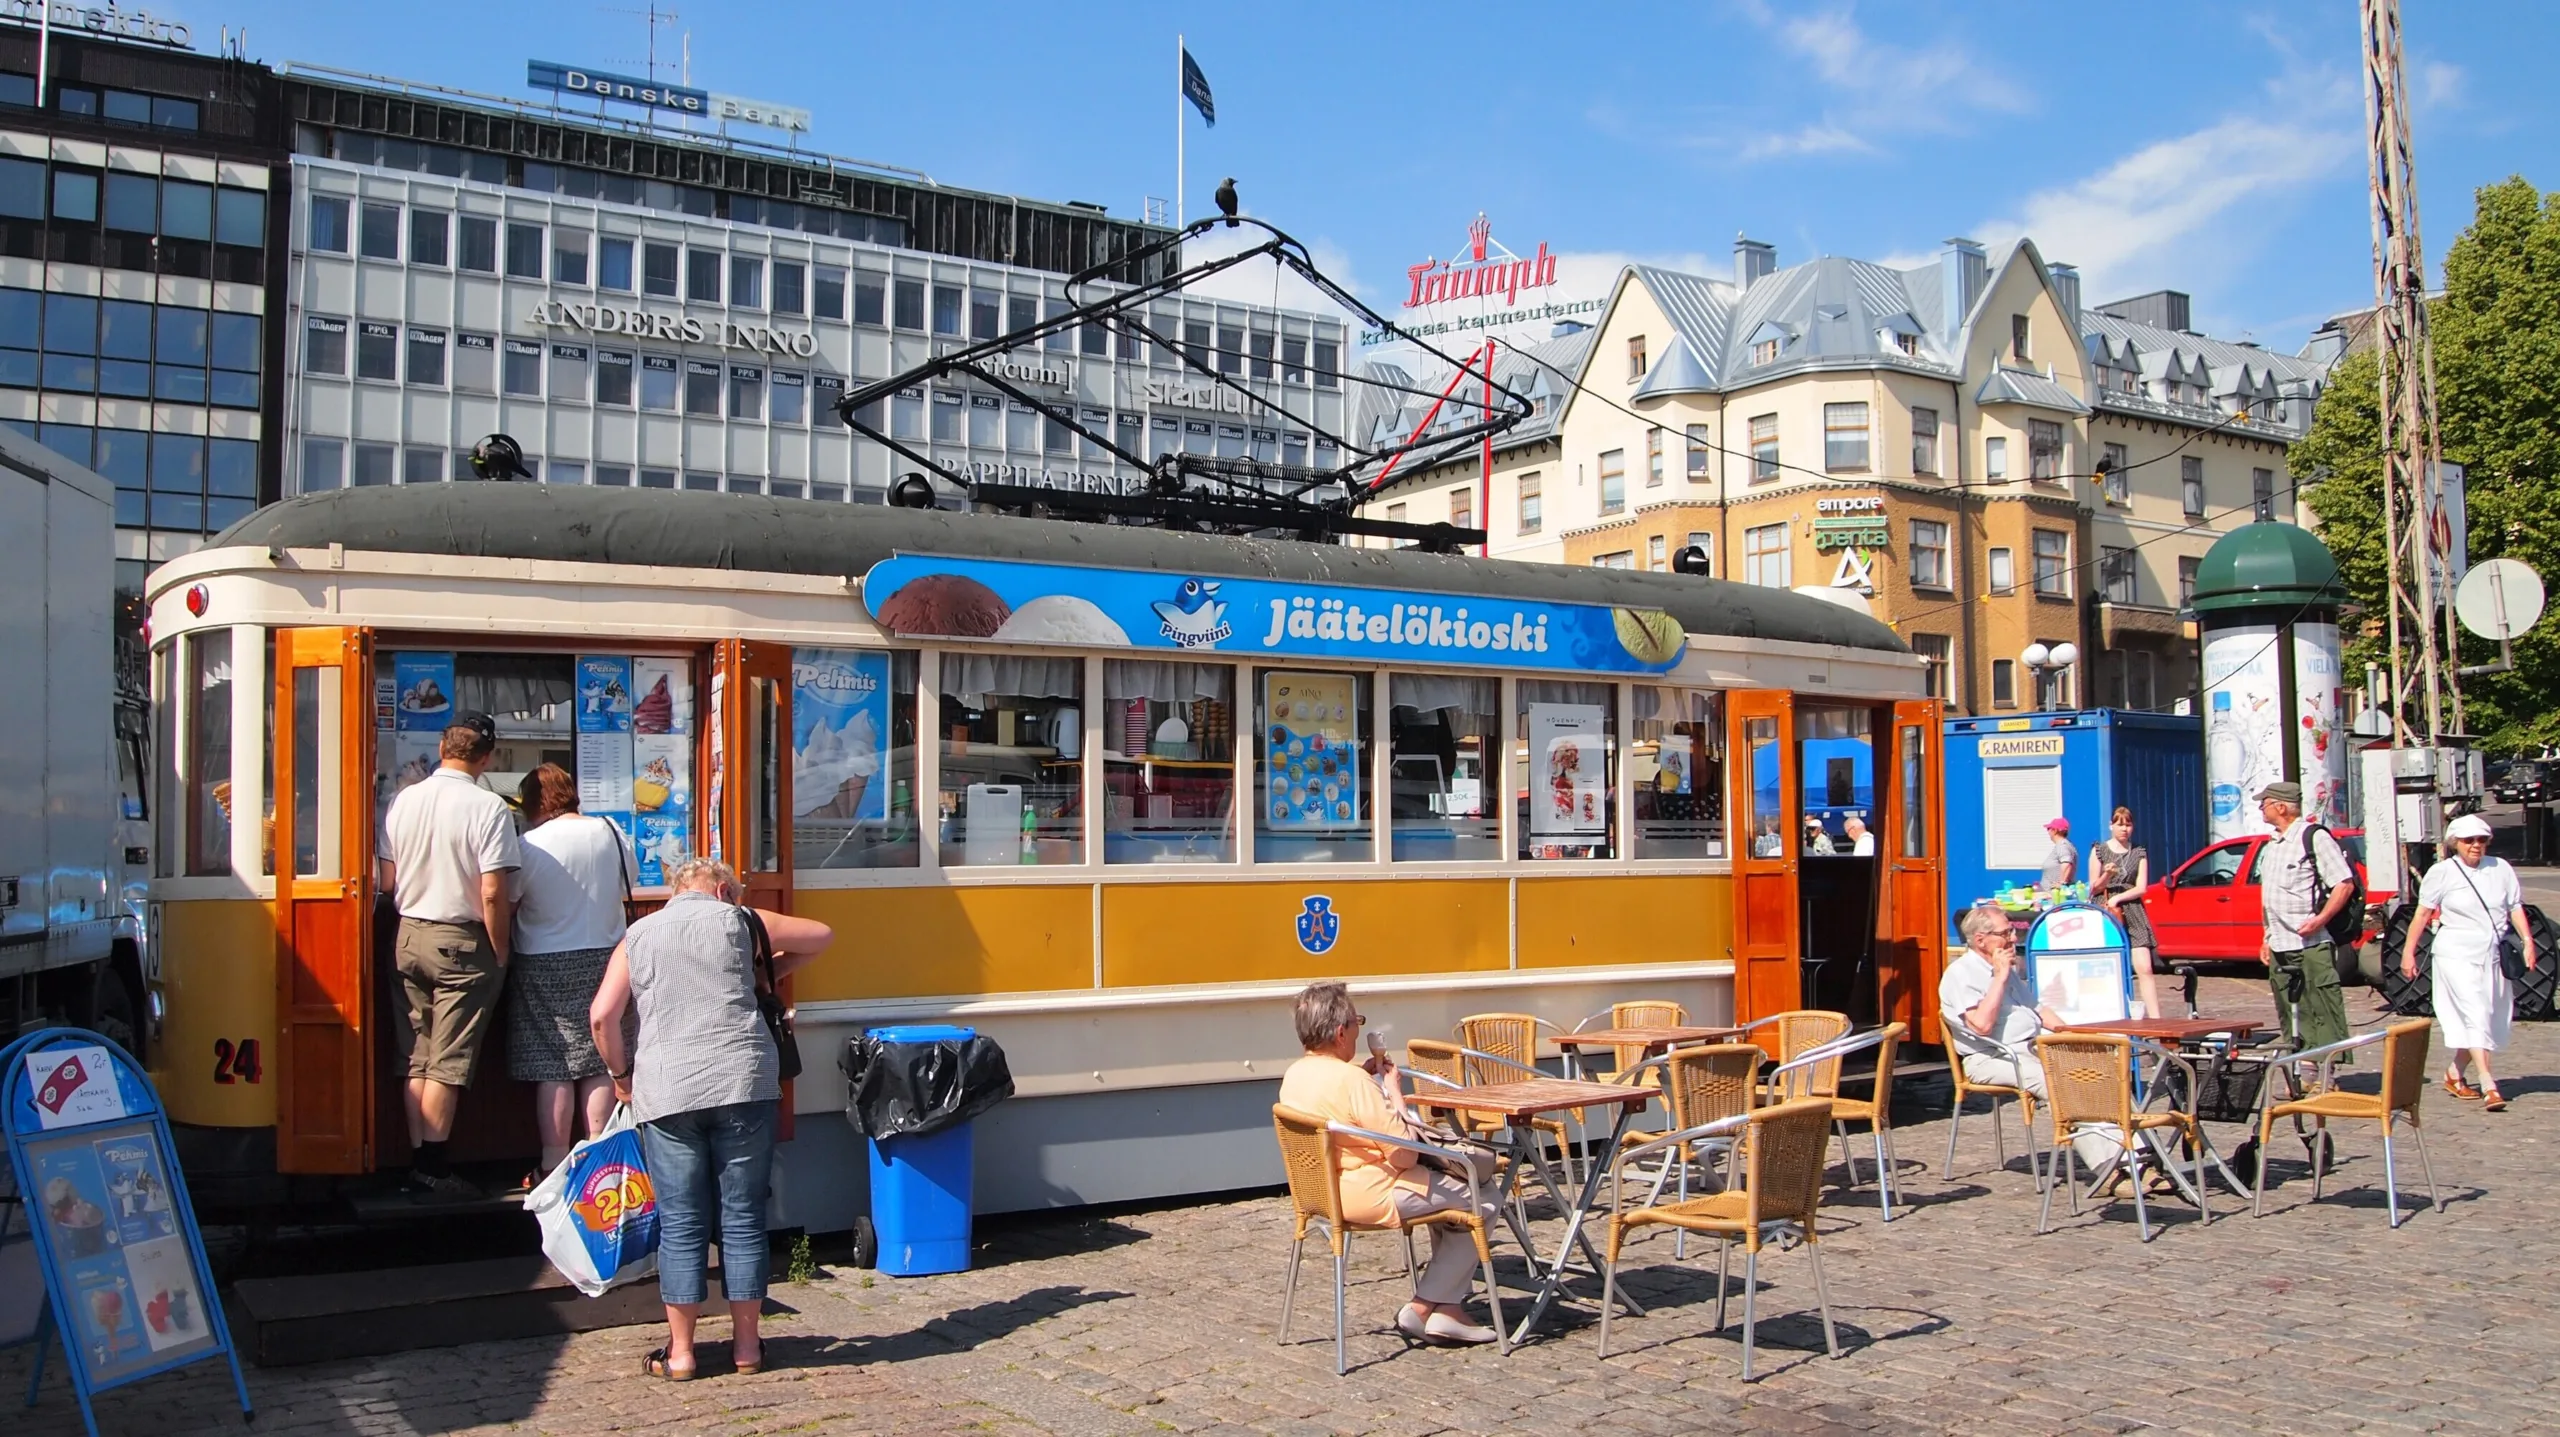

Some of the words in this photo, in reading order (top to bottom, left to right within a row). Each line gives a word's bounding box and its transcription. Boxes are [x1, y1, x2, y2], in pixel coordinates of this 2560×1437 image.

[567, 71, 699, 110] Danske
[720, 101, 808, 131] Bank
[1403, 241, 1558, 308] Triumph
[367, 324, 389, 335] PPG
[525, 301, 705, 344] ANDERS
[715, 321, 819, 358] INNO
[465, 336, 486, 346] PPG
[560, 347, 580, 358] PPG
[651, 357, 669, 368] PPG
[738, 368, 755, 378] PPG
[821, 378, 838, 388] PPG
[1816, 497, 1883, 515] empore
[1263, 596, 1549, 653] Jäätelökioski
[1160, 621, 1232, 648] Pingviini
[792, 663, 876, 692] Pehmis
[1993, 739, 2059, 755] RAMIRENT
[641, 816, 681, 827] Pehmis
[151, 905, 160, 977] 3
[213, 1037, 262, 1085] 24
[105, 1148, 148, 1162] Pehmis
[594, 1179, 645, 1224] 20
